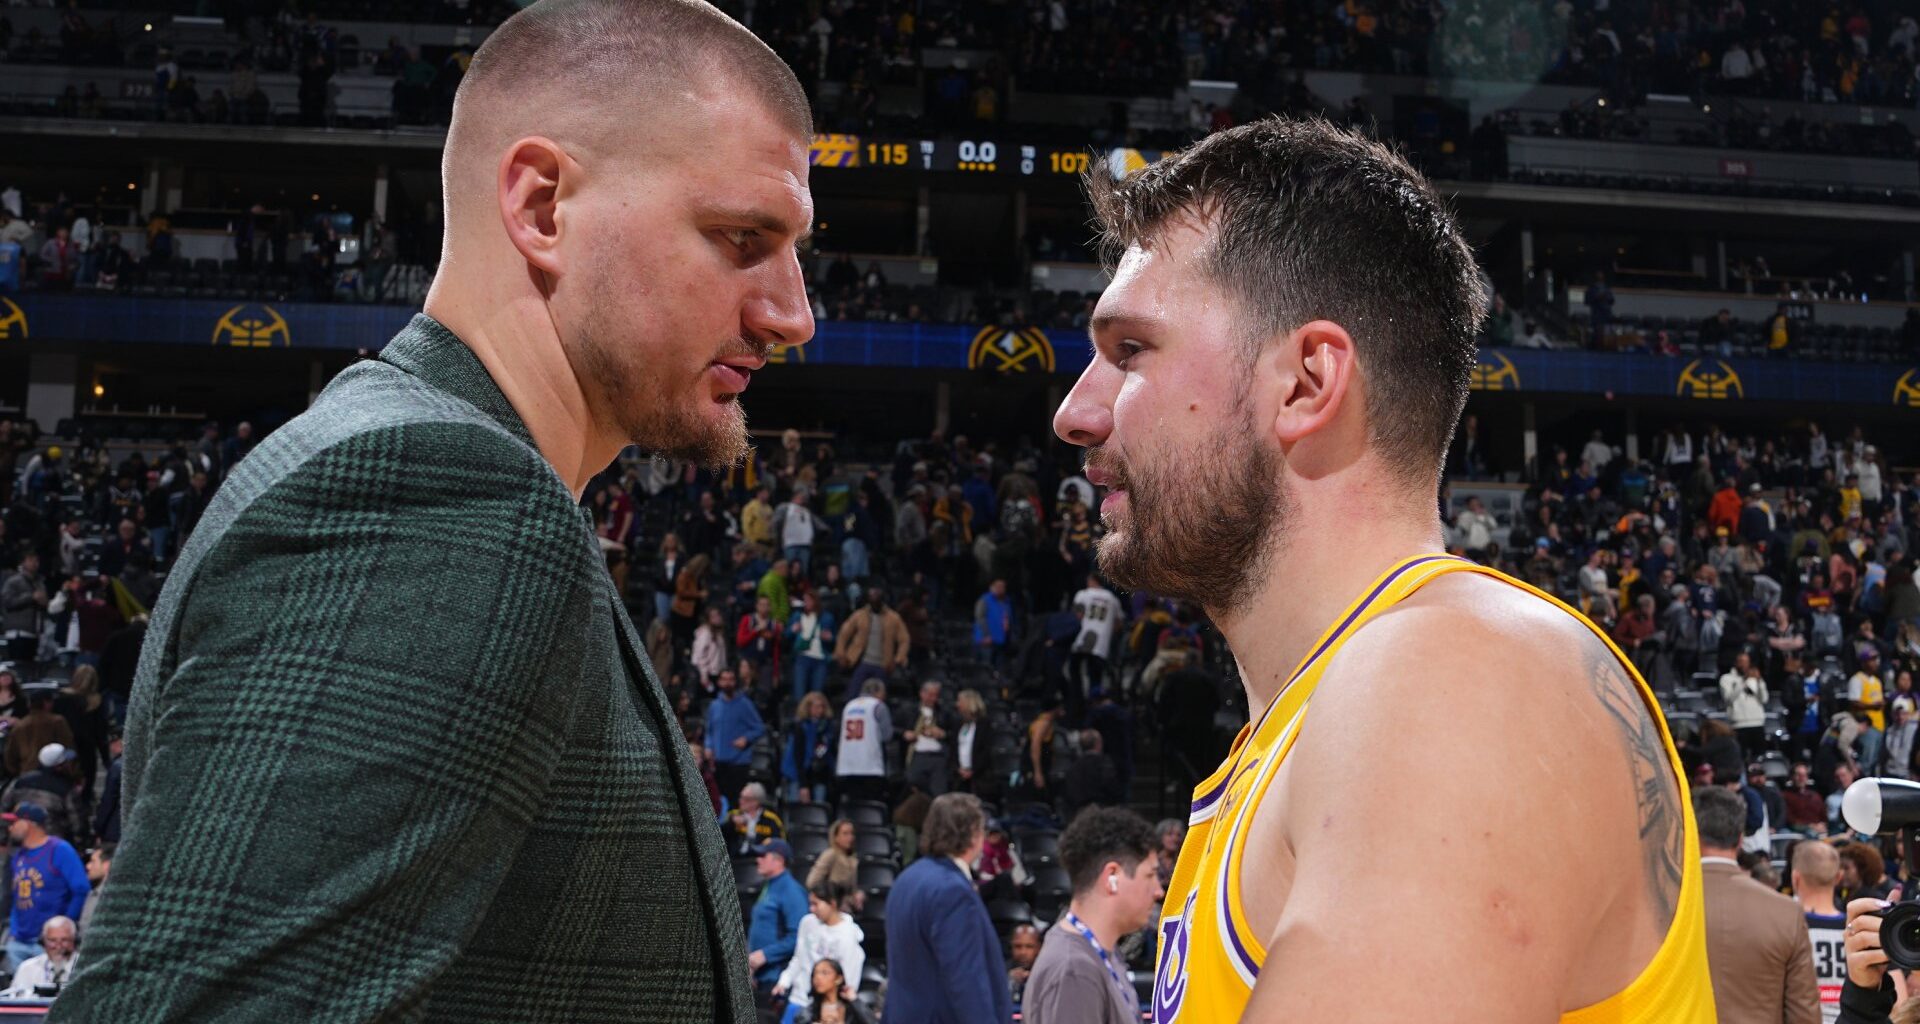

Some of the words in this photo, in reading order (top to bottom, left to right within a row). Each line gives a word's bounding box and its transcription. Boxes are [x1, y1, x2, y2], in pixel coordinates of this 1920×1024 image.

[867, 143, 908, 165] 115
[958, 140, 996, 162] 0.0
[1050, 152, 1089, 173] 107
